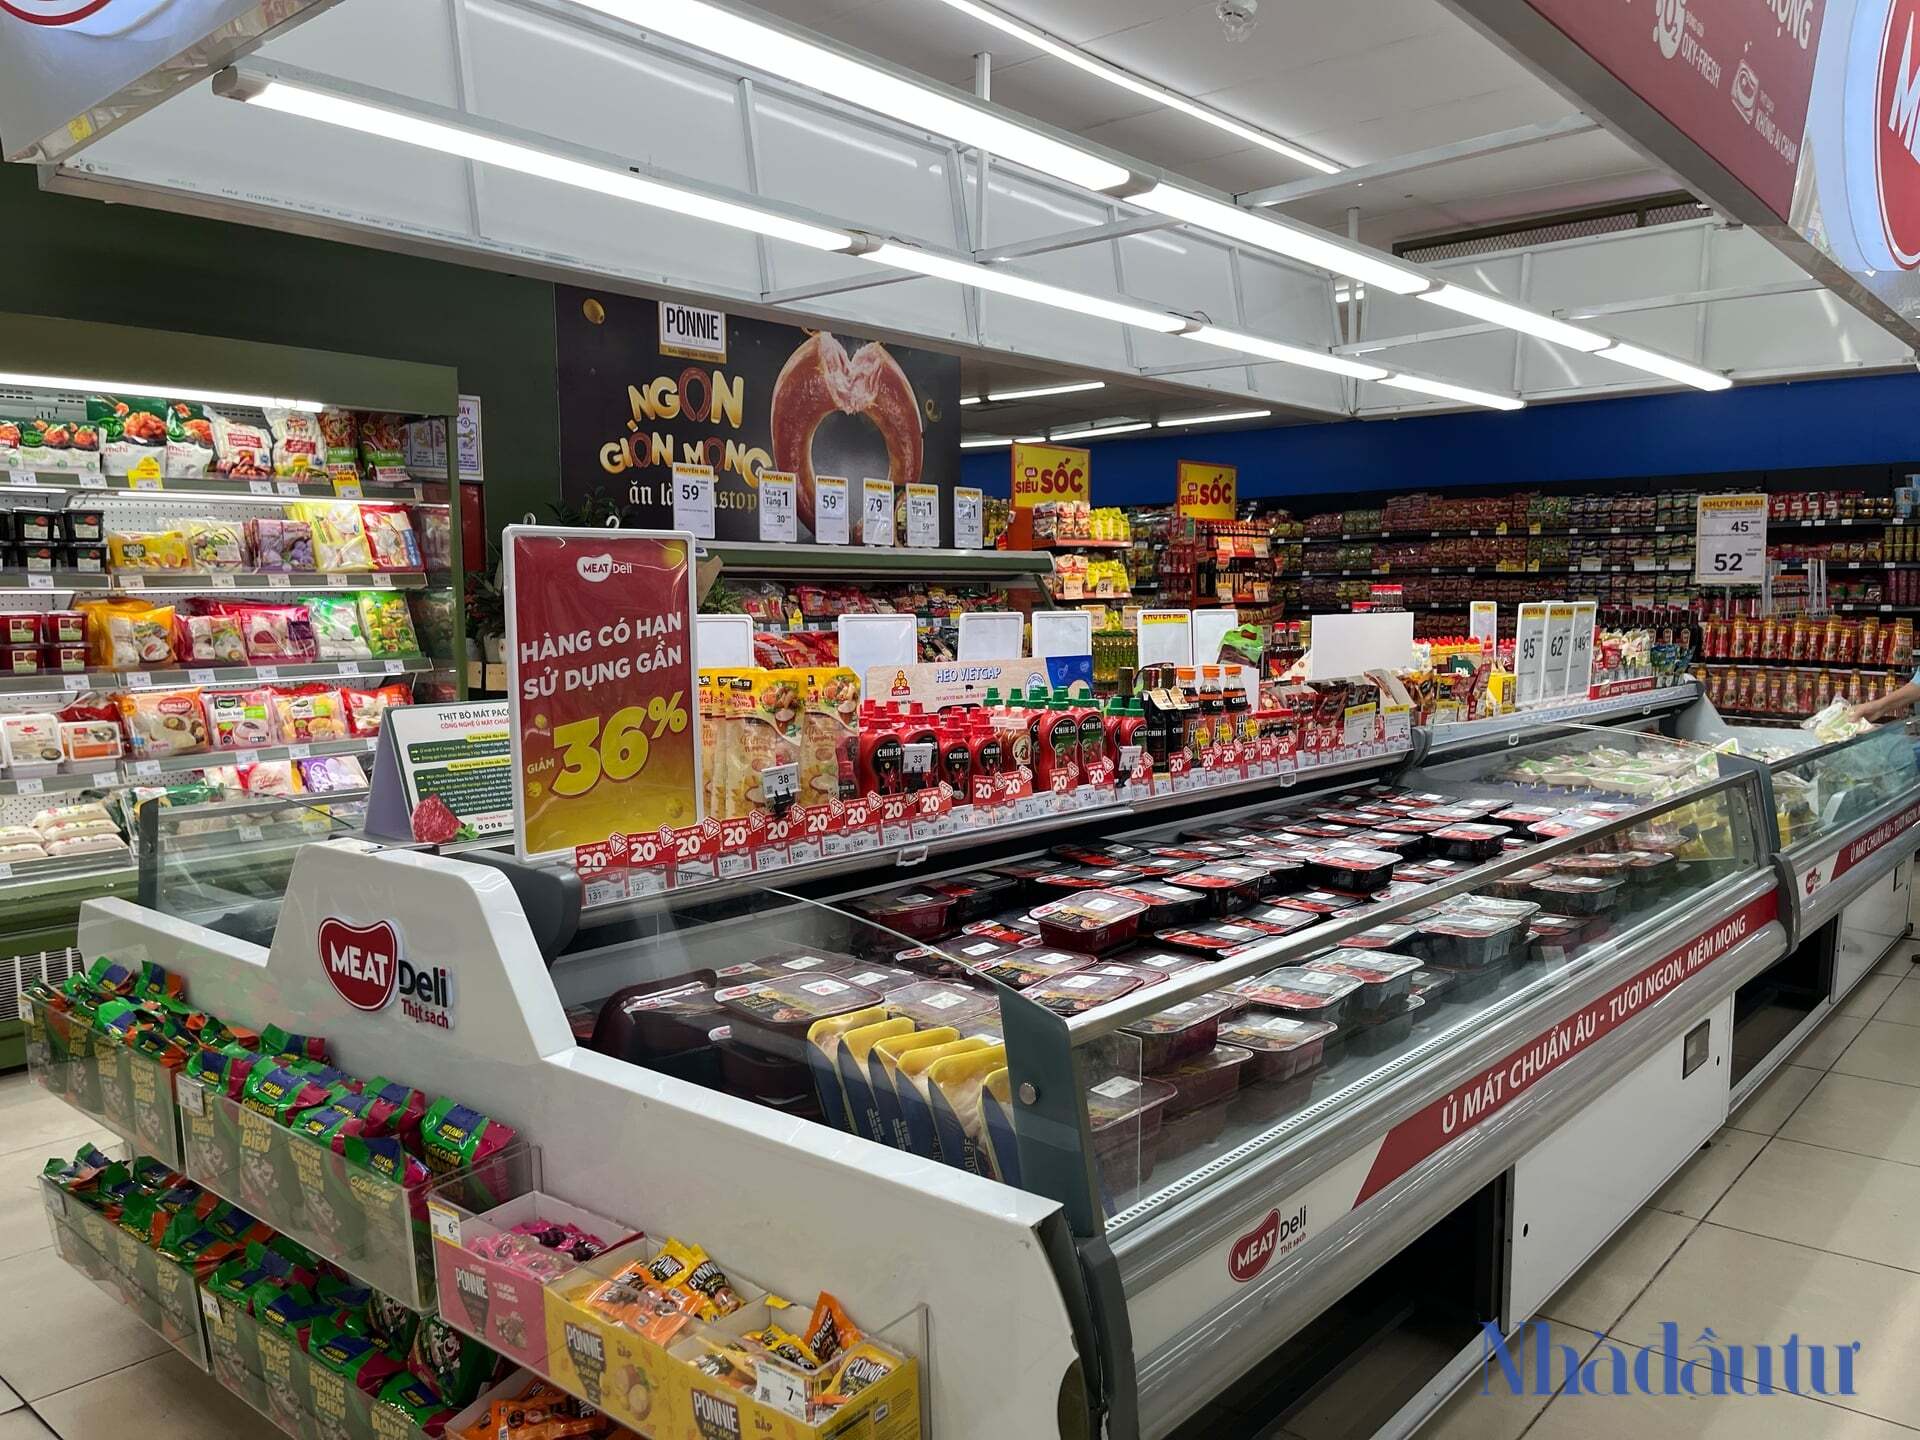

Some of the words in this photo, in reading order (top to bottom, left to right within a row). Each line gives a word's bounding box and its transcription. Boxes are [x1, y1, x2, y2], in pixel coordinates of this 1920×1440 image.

[1681, 33, 1721, 88] OXY-FRESH
[627, 367, 745, 428] NGON
[1040, 458, 1084, 494] SỐC
[629, 481, 652, 506] ăn
[682, 485, 699, 500] 59
[782, 492, 788, 507] 1
[1200, 474, 1232, 506] SỐC
[823, 495, 837, 509] 59
[869, 498, 882, 513] 79
[777, 515, 785, 523] 30
[1731, 521, 1749, 532] 45
[583, 562, 609, 574] MEAT
[613, 563, 632, 574] Deli
[1714, 553, 1743, 572] 52
[521, 630, 592, 665] HÀNG
[598, 617, 631, 647] CÓ
[637, 611, 682, 641] HẠN
[1523, 637, 1535, 659] 95
[1551, 636, 1564, 657] 62
[523, 667, 559, 700] SỬ
[565, 657, 631, 693] DỤNG
[636, 640, 682, 673] GẦN
[935, 668, 958, 684] HEO
[960, 665, 1002, 682] VIETGAP
[438, 711, 457, 722] THỊT
[473, 709, 491, 718] MÁT
[552, 690, 688, 797] 36%
[527, 757, 555, 775] GIẢM
[913, 755, 922, 764] 33
[778, 773, 789, 784] 38
[330, 941, 389, 987] MEAT
[398, 960, 447, 1008] Deli
[401, 999, 424, 1023] Thịt
[1441, 1095, 1458, 1135] Ủ
[1462, 1071, 1507, 1123] MÁT
[1509, 1025, 1570, 1089] CHUẨN
[1573, 1011, 1596, 1045] ÂU
[1609, 981, 1643, 1024] TƯƠI
[1645, 957, 1685, 998] NGON,
[1687, 934, 1713, 970] MỀM
[1715, 914, 1746, 956] MỌNG
[448, 1223, 454, 1234] 6
[1237, 1228, 1275, 1271] MEAT
[1280, 1205, 1306, 1242] Deli
[1280, 1241, 1292, 1256] Thịt
[1292, 1232, 1307, 1248] sạch
[785, 1386, 794, 1401] 7
